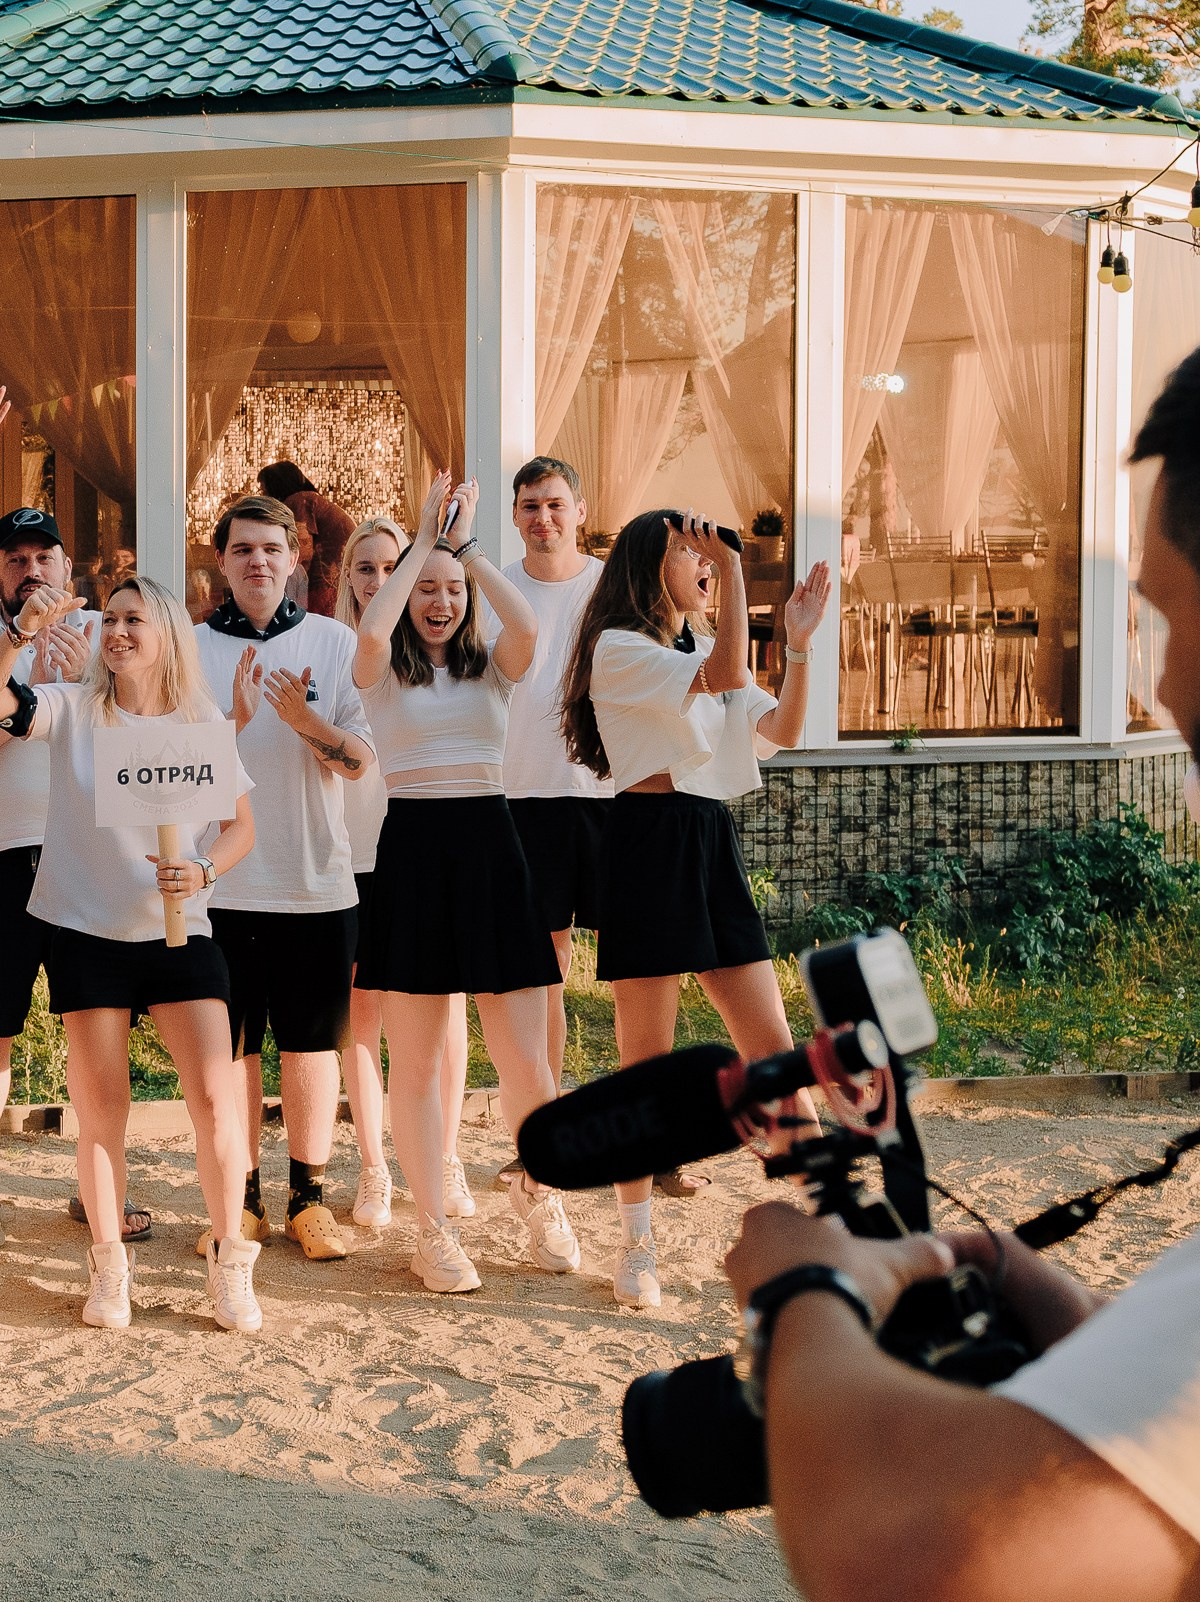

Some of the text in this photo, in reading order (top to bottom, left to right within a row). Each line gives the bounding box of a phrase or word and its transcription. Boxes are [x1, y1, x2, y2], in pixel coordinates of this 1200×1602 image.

[116, 763, 214, 786] 6 ОТРЯД
[132, 799, 171, 815] СМЕНА
